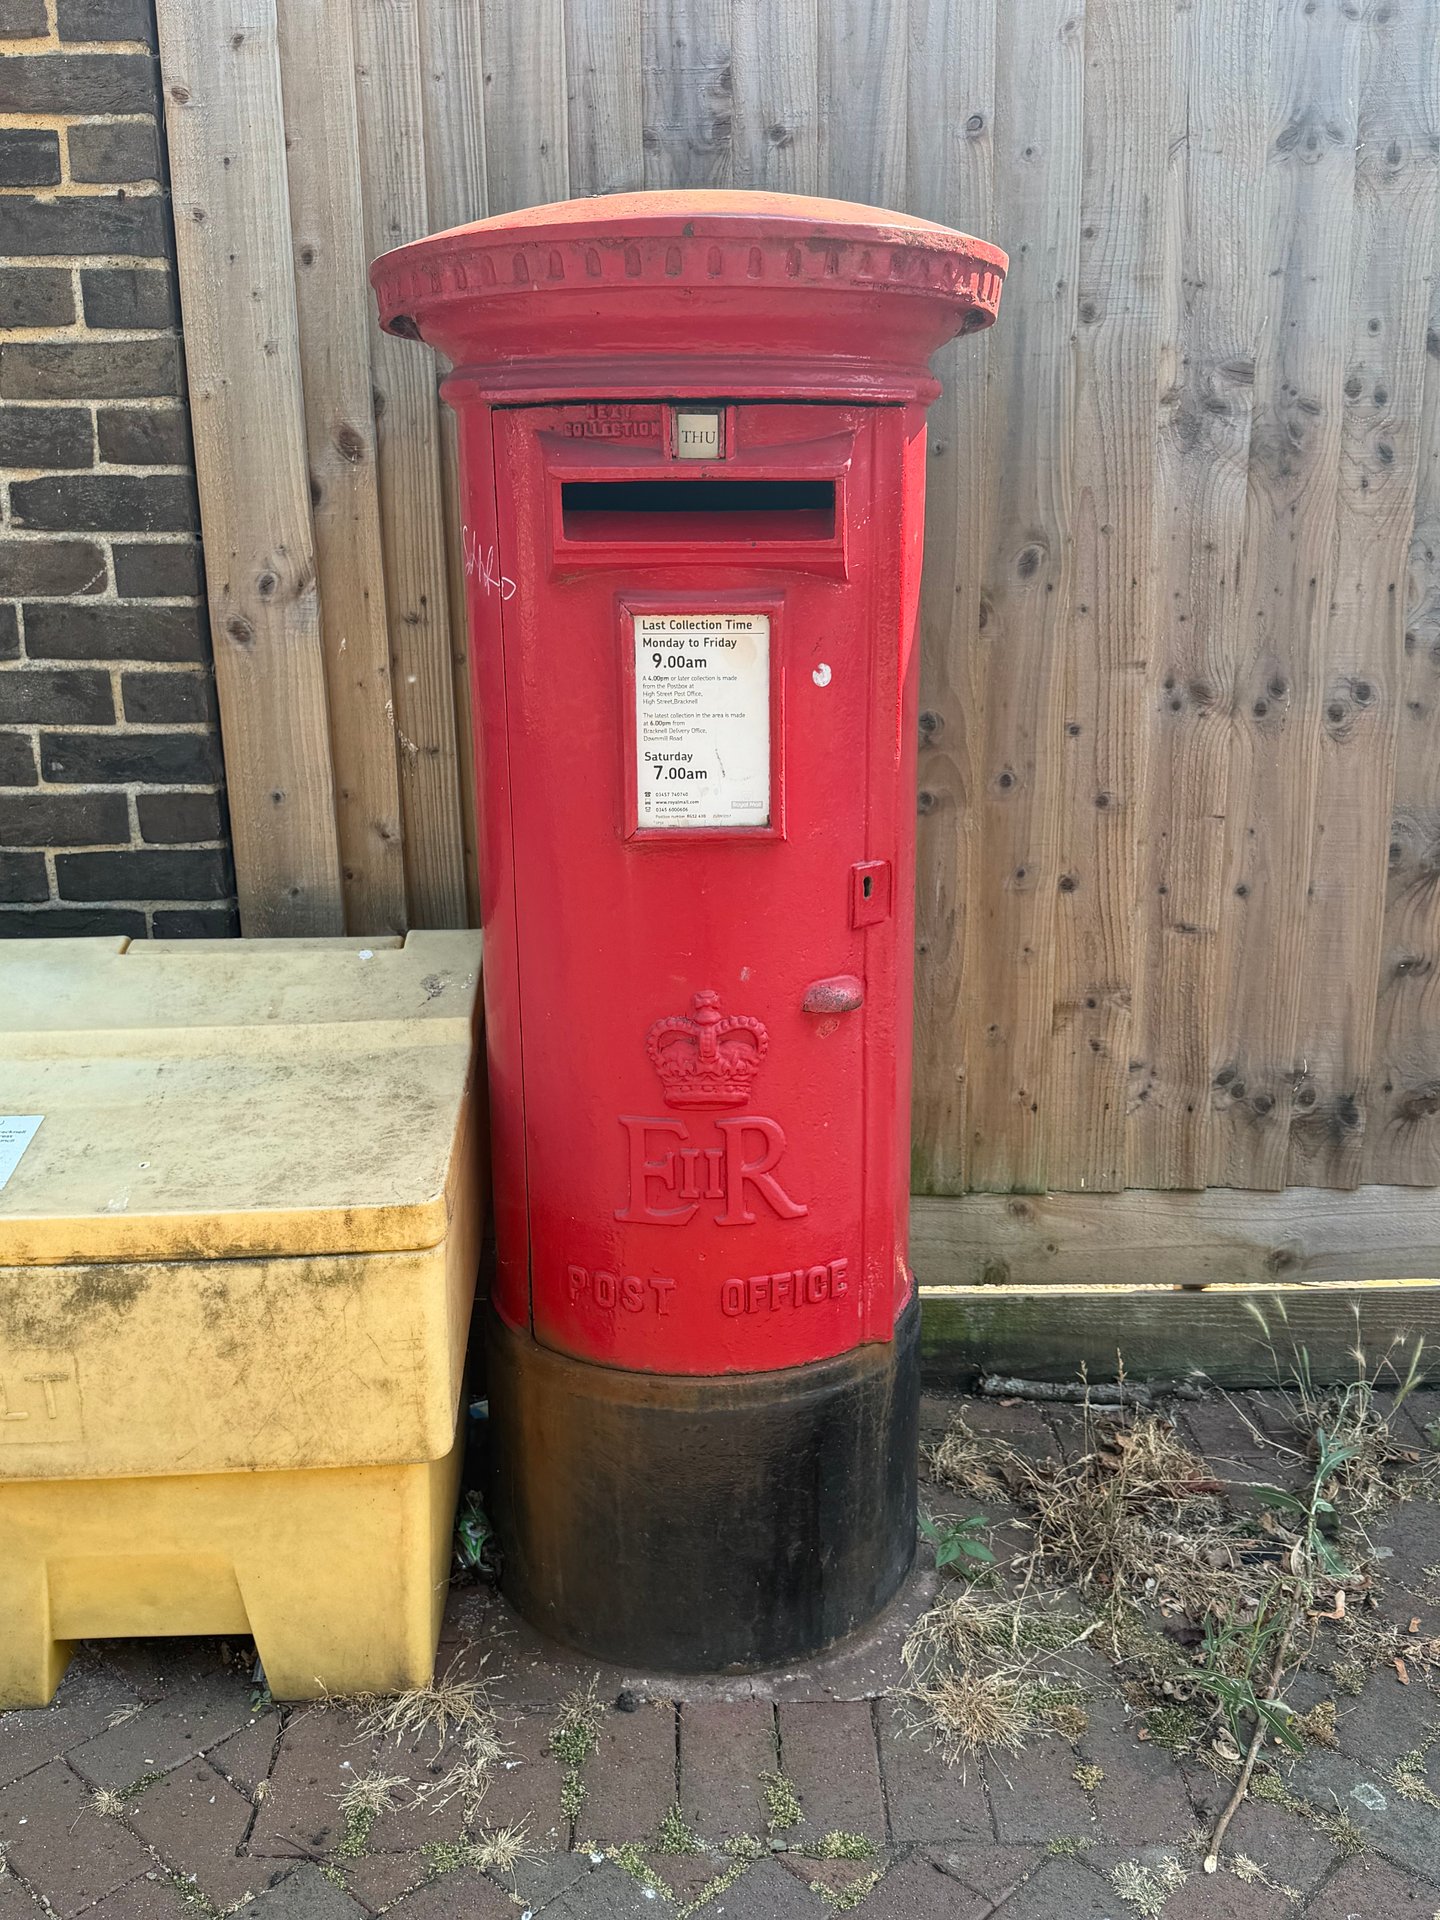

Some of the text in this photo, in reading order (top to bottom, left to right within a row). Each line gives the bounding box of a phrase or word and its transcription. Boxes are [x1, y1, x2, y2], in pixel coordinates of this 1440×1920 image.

[563, 420, 661, 438] COLLECTION
[681, 430, 717, 445] THU
[642, 619, 753, 630] Last Collection Time
[642, 637, 737, 649] Monday to Friday
[652, 652, 707, 669] 9.00am
[644, 751, 693, 763] Saturday
[653, 765, 708, 780] 7.00am
[567, 1257, 850, 1318] POST OFFICE
